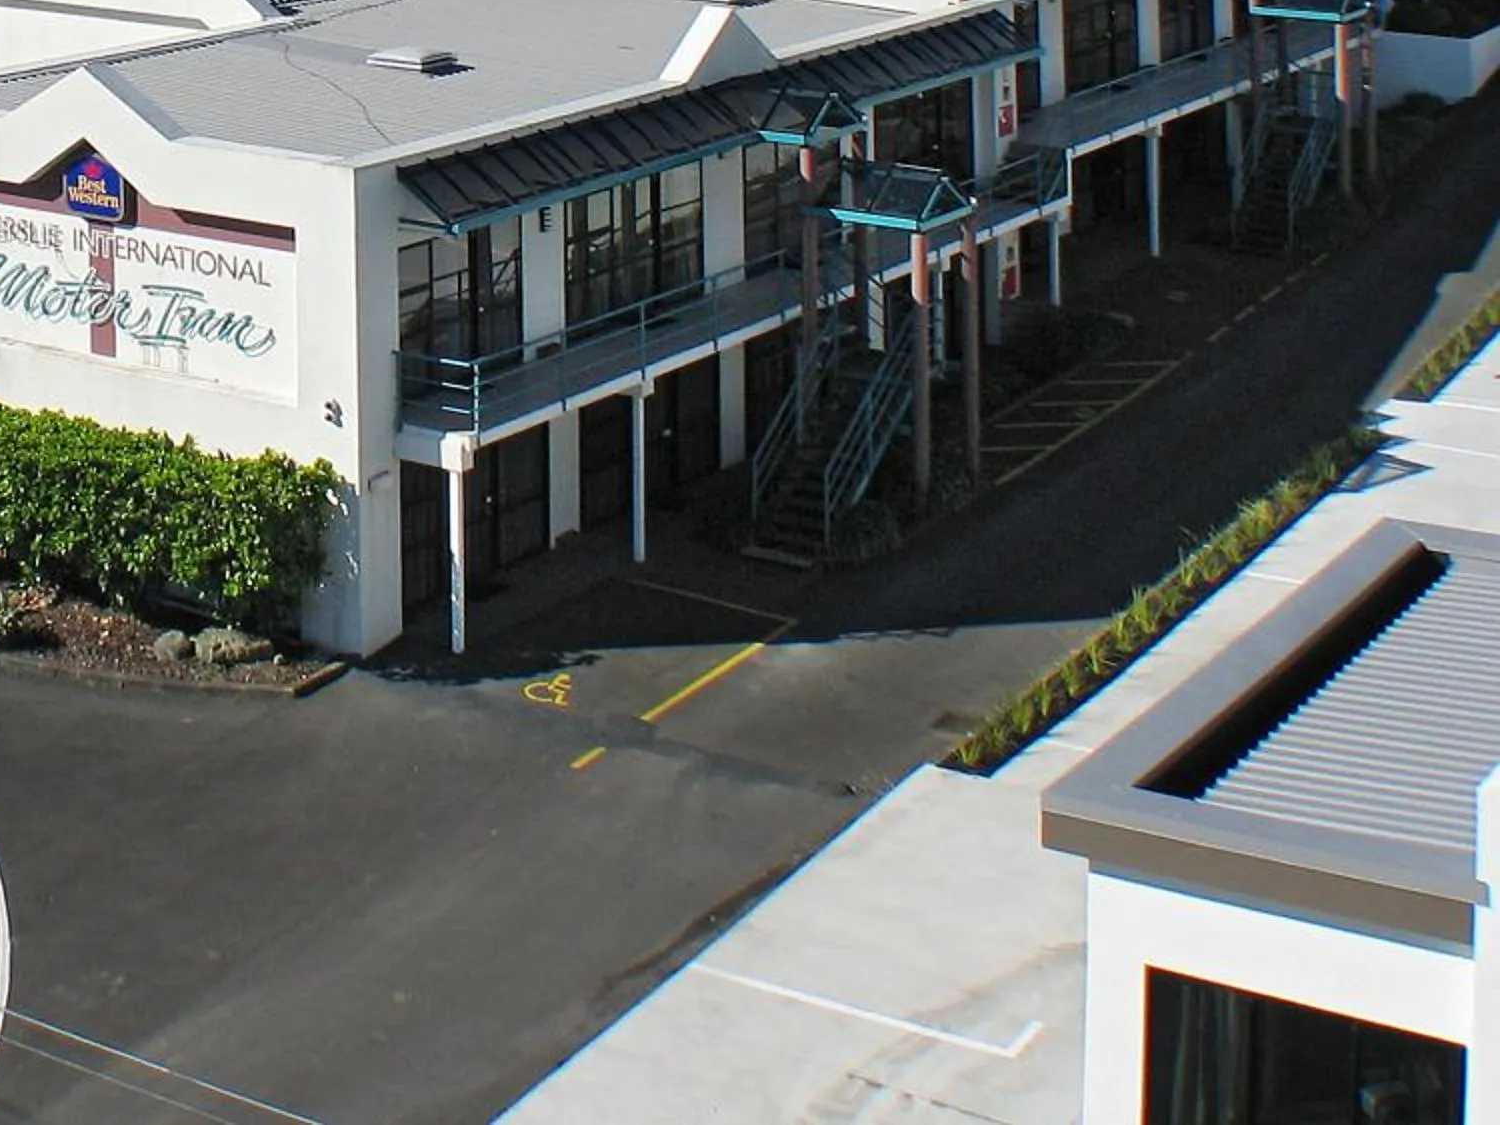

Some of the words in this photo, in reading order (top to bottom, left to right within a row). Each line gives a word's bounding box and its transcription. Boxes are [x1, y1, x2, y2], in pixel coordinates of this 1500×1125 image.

[67, 186, 118, 208] Western
[77, 174, 106, 193] Best
[73, 228, 271, 287] INTERNATIONAL
[134, 284, 277, 357] Inn
